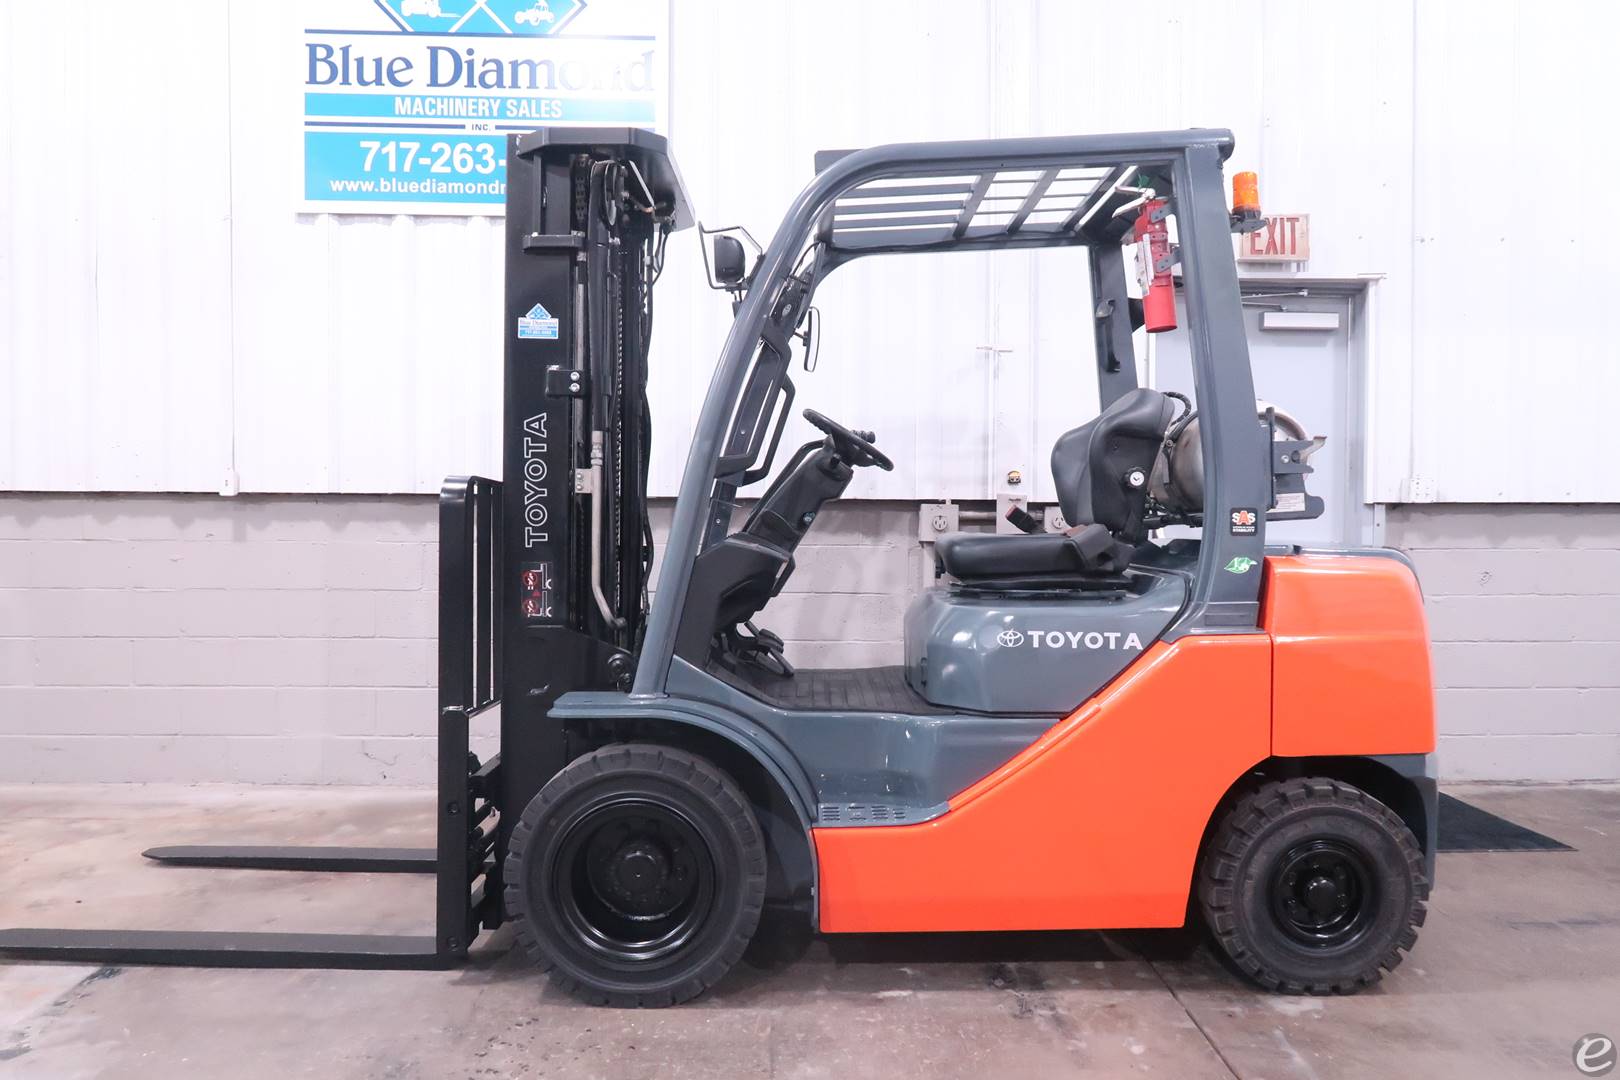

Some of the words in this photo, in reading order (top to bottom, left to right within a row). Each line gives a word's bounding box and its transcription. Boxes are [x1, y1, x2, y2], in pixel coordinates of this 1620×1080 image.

[305, 43, 414, 88] Blue
[426, 45, 656, 92] Diamond
[394, 96, 501, 118] MACHINERY
[506, 99, 563, 119] SALES
[471, 123, 491, 132] INC.
[1250, 217, 1300, 256] EXIT
[524, 412, 548, 548] TOYOTA
[1231, 510, 1256, 526] SAS
[1027, 630, 1144, 651] TOYOTA
